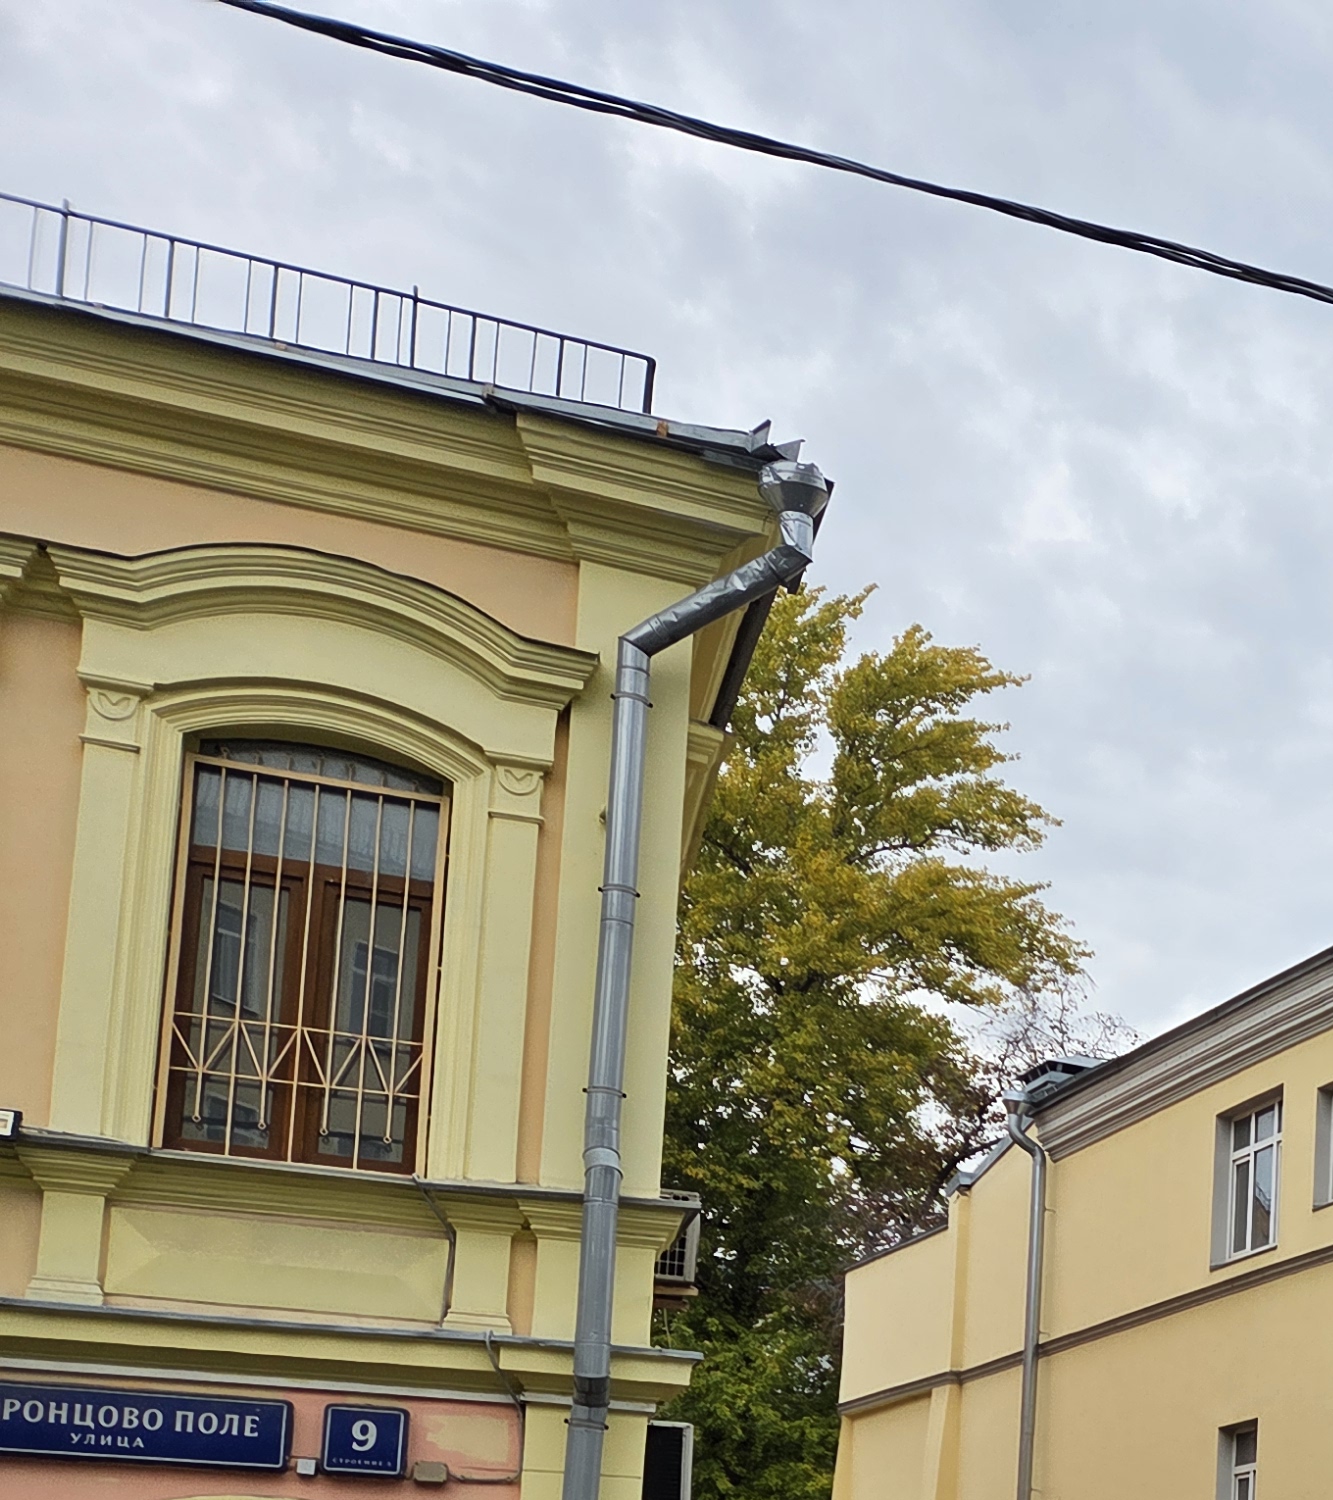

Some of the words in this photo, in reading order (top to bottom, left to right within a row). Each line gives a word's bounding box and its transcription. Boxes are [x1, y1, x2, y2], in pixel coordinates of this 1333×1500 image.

[1, 1398, 164, 1431] РОНЦОВО
[174, 1410, 260, 1437] ПОЛЕ
[70, 1432, 145, 1448] УЛИЦА
[351, 1419, 377, 1451] 9
